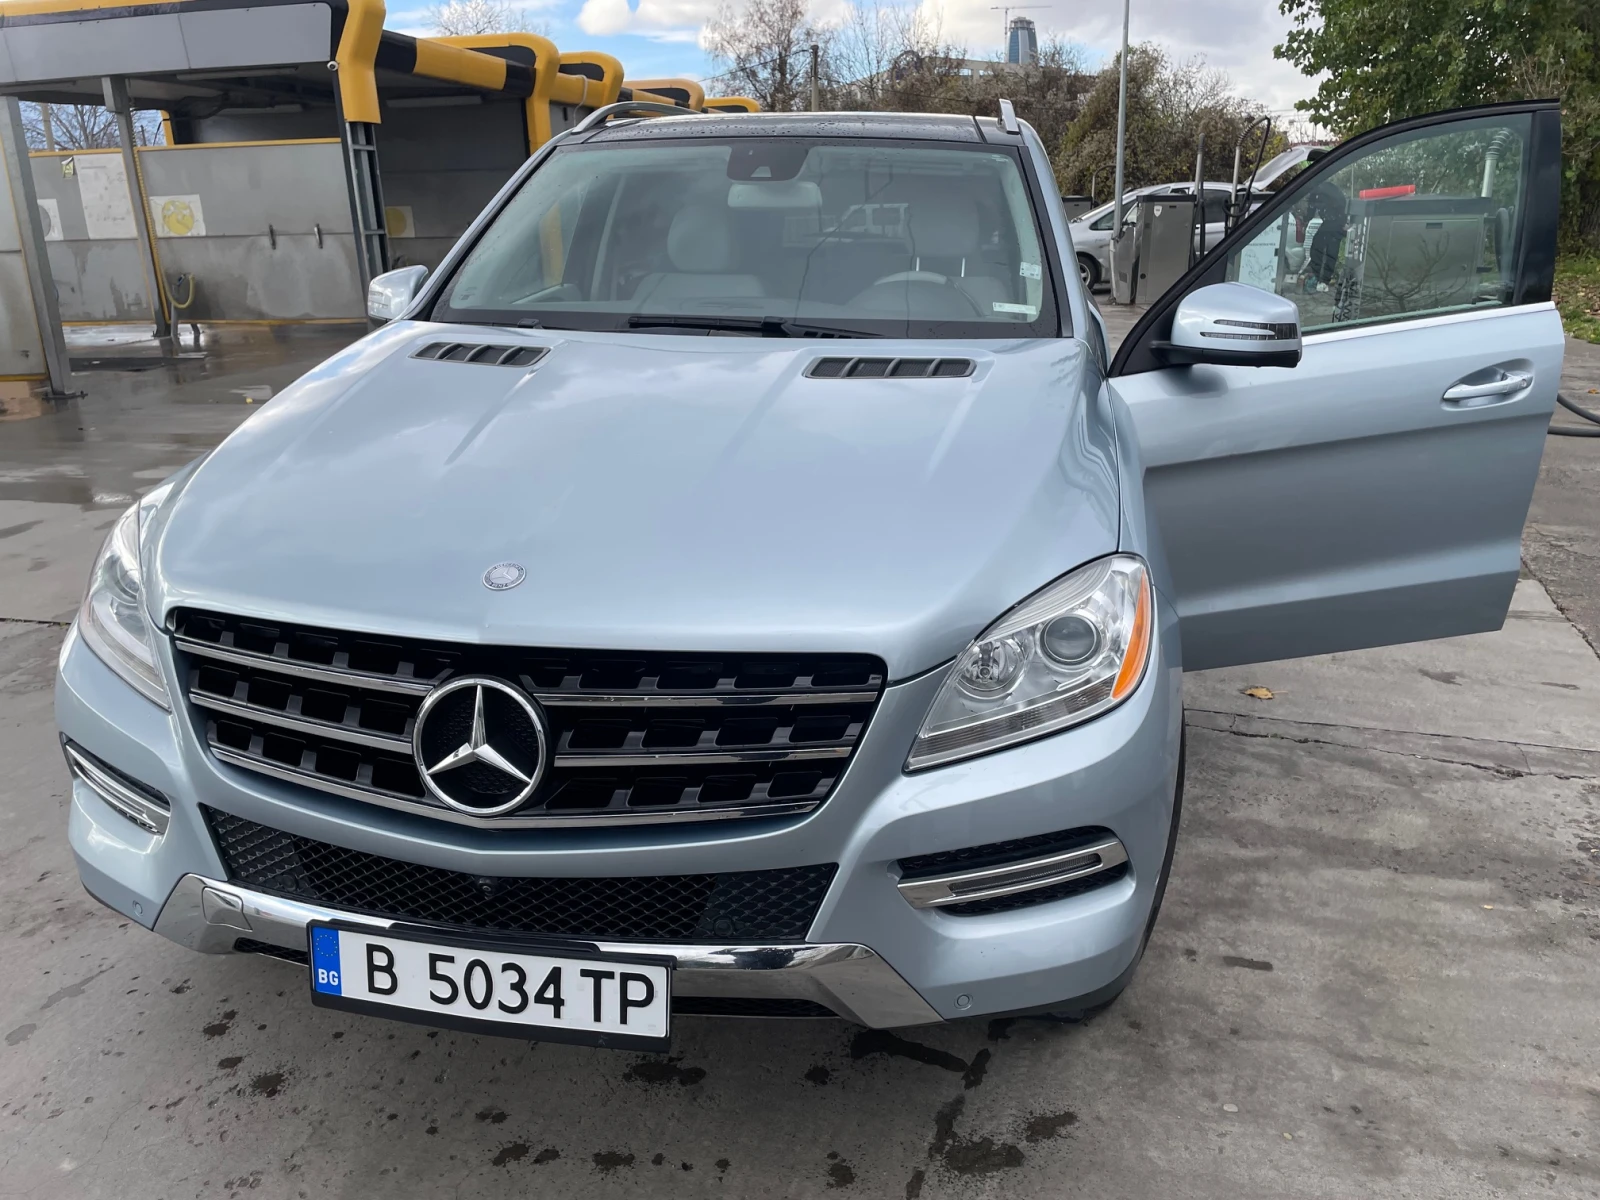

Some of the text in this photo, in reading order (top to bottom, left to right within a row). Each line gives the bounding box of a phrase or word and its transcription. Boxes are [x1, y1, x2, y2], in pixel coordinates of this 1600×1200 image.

[318, 968, 339, 986] BG
[366, 943, 655, 1025] B 5034 TP
